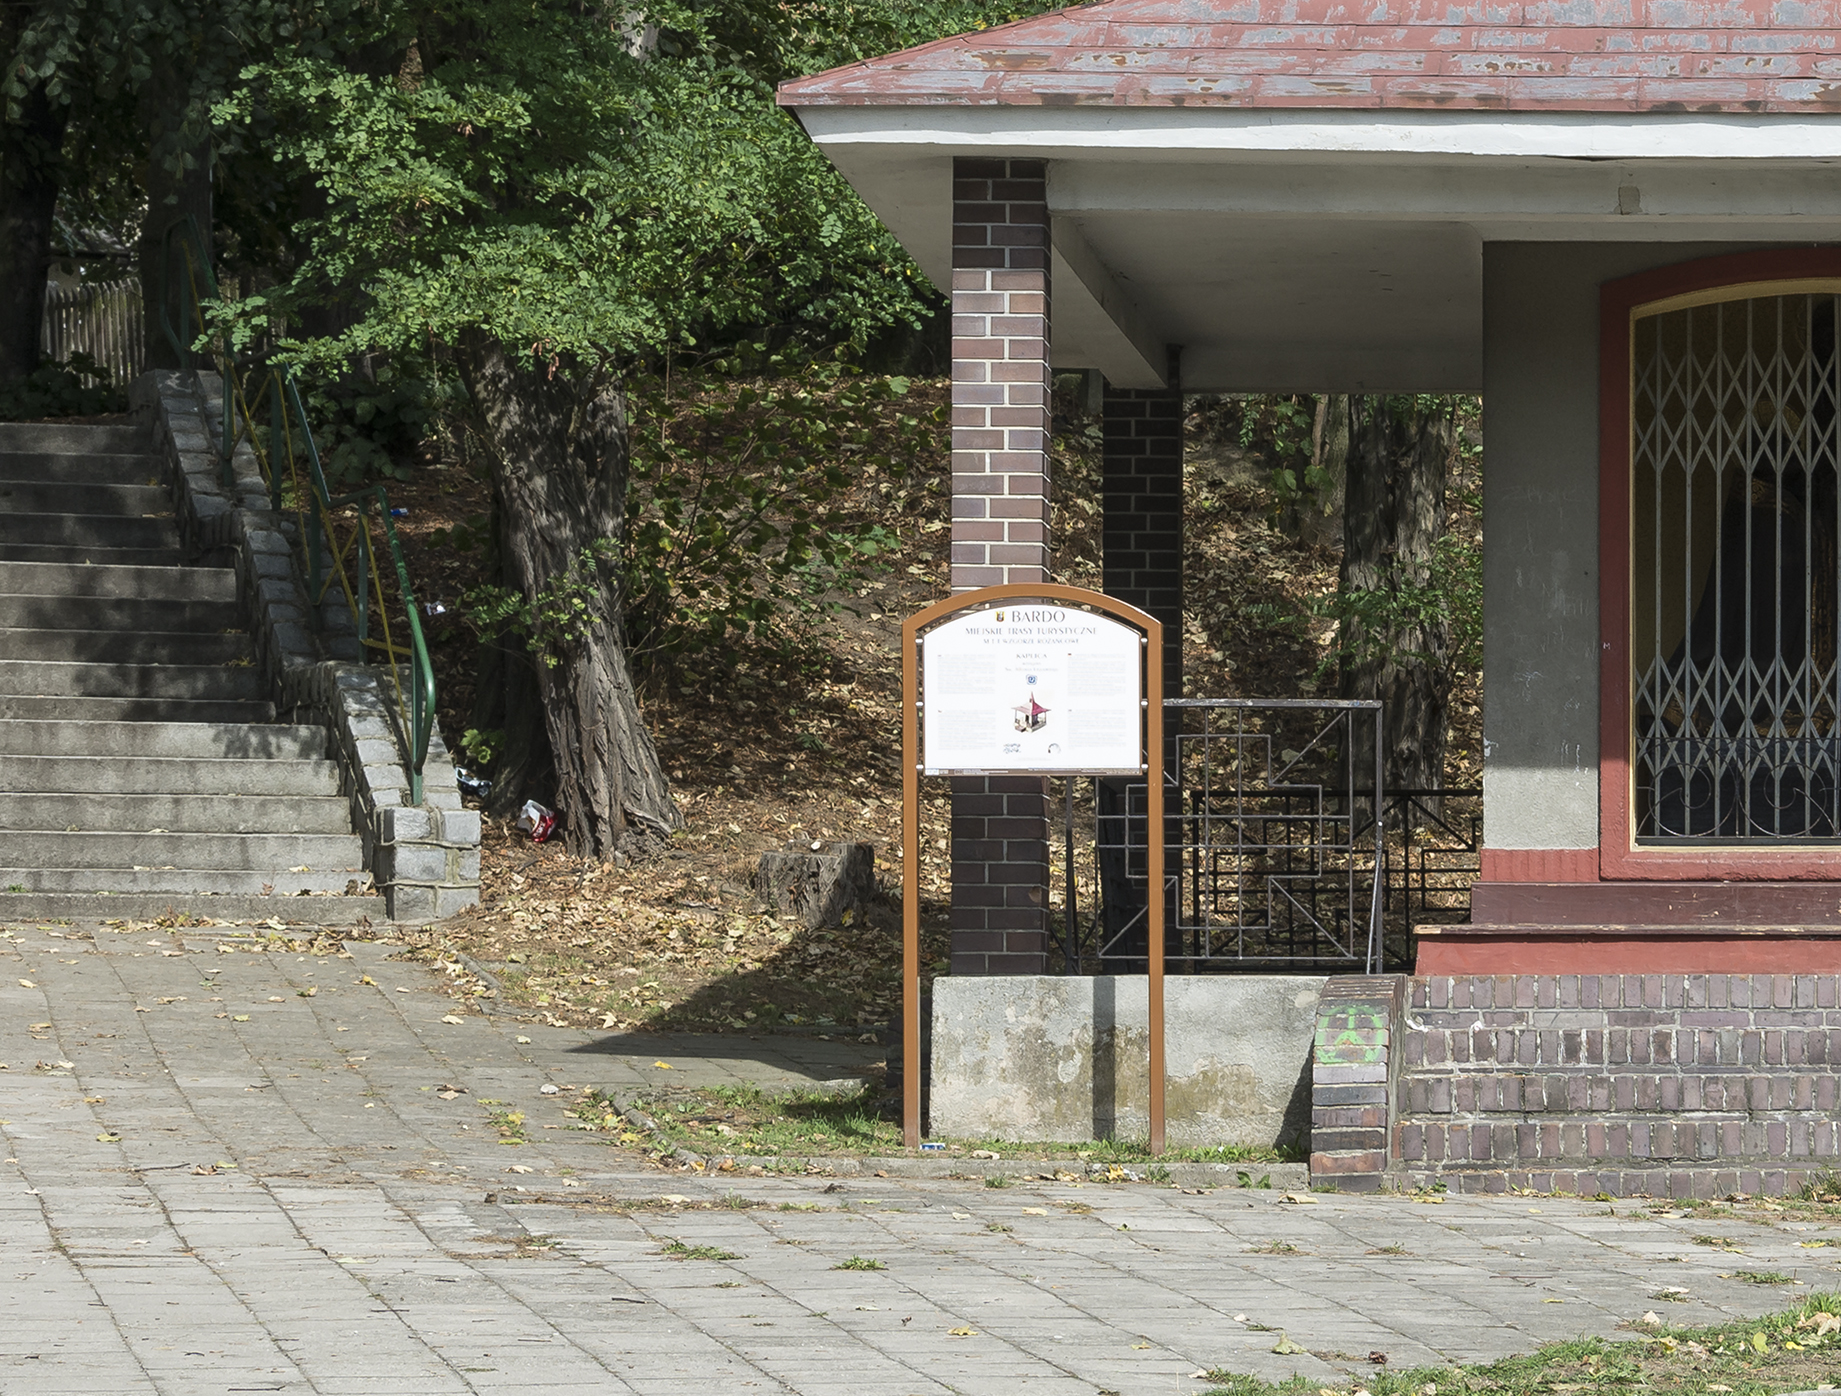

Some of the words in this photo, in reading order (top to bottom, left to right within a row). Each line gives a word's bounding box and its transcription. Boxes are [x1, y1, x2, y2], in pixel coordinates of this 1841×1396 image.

[1011, 610, 1066, 623] BARDO
[965, 627, 1003, 635] MIEJSKIE
[1008, 627, 1033, 635] TRASY
[1037, 627, 1097, 635] TURYSTYCZNE
